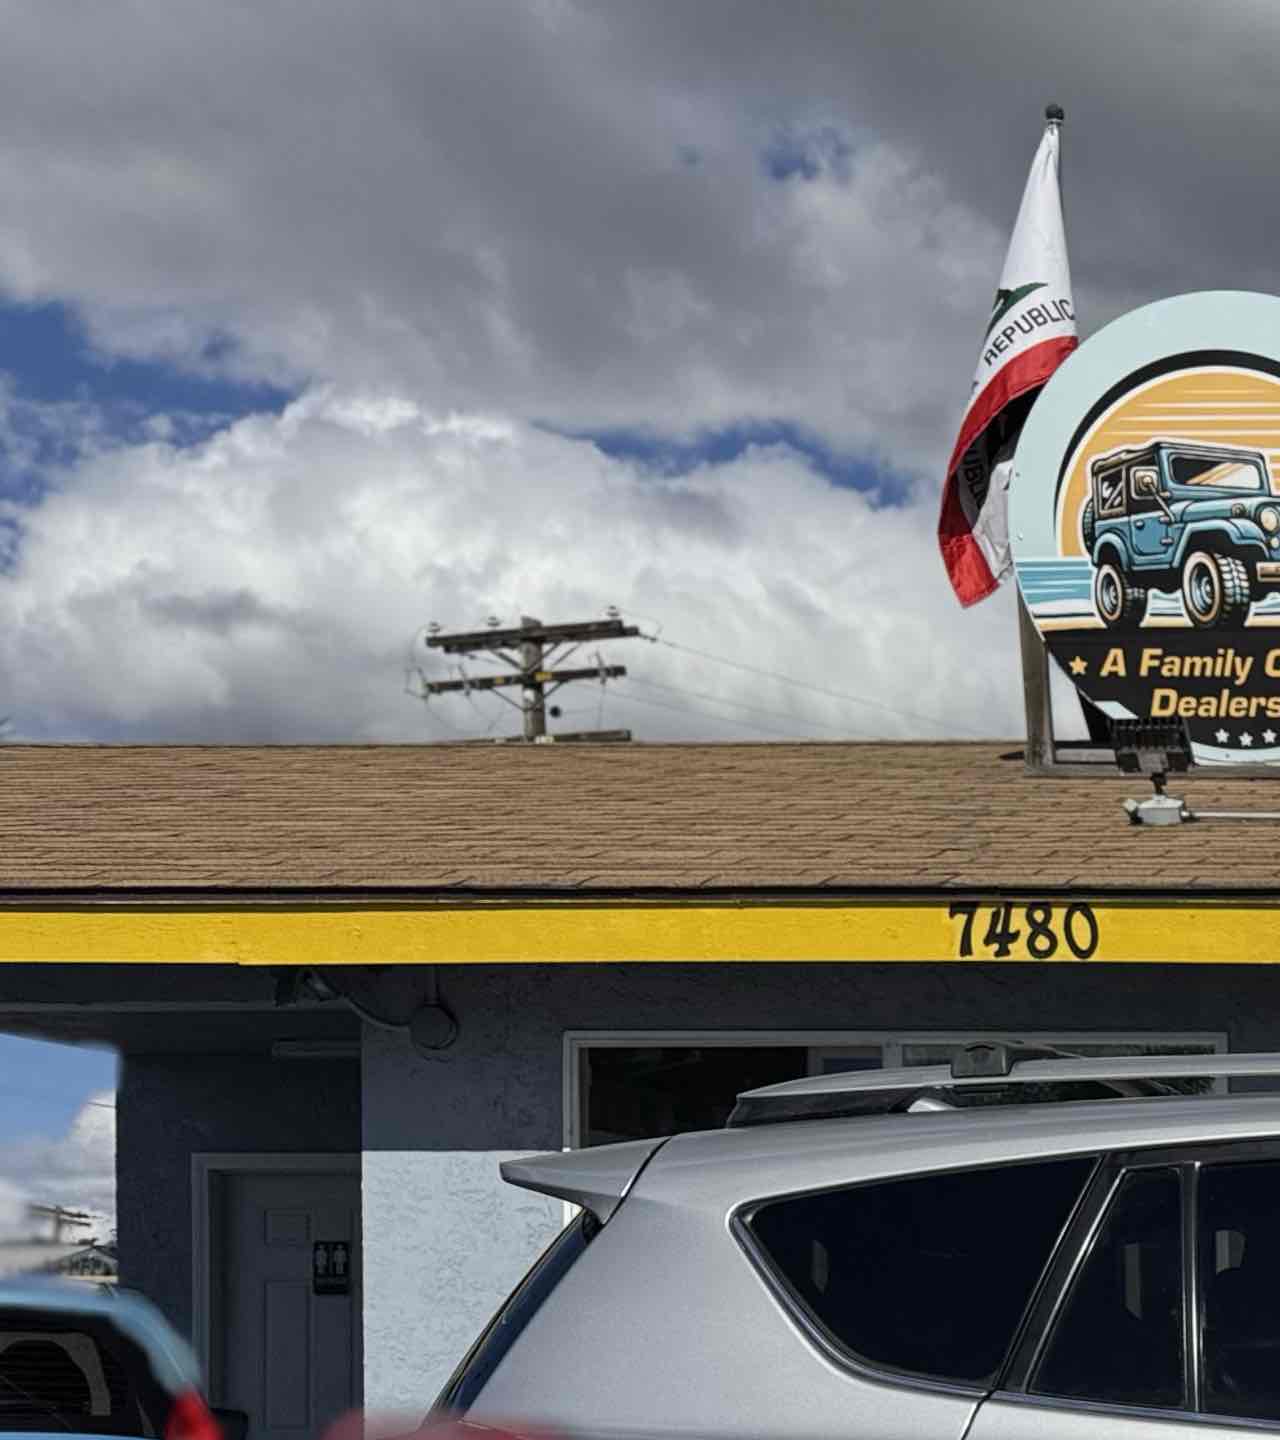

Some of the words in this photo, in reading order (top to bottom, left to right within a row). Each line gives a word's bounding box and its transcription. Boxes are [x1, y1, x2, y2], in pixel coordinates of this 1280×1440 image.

[984, 299, 1076, 366] REPUBLIC
[1099, 648, 1127, 677] A
[1139, 648, 1253, 685] Family
[948, 902, 1099, 959] 7480
